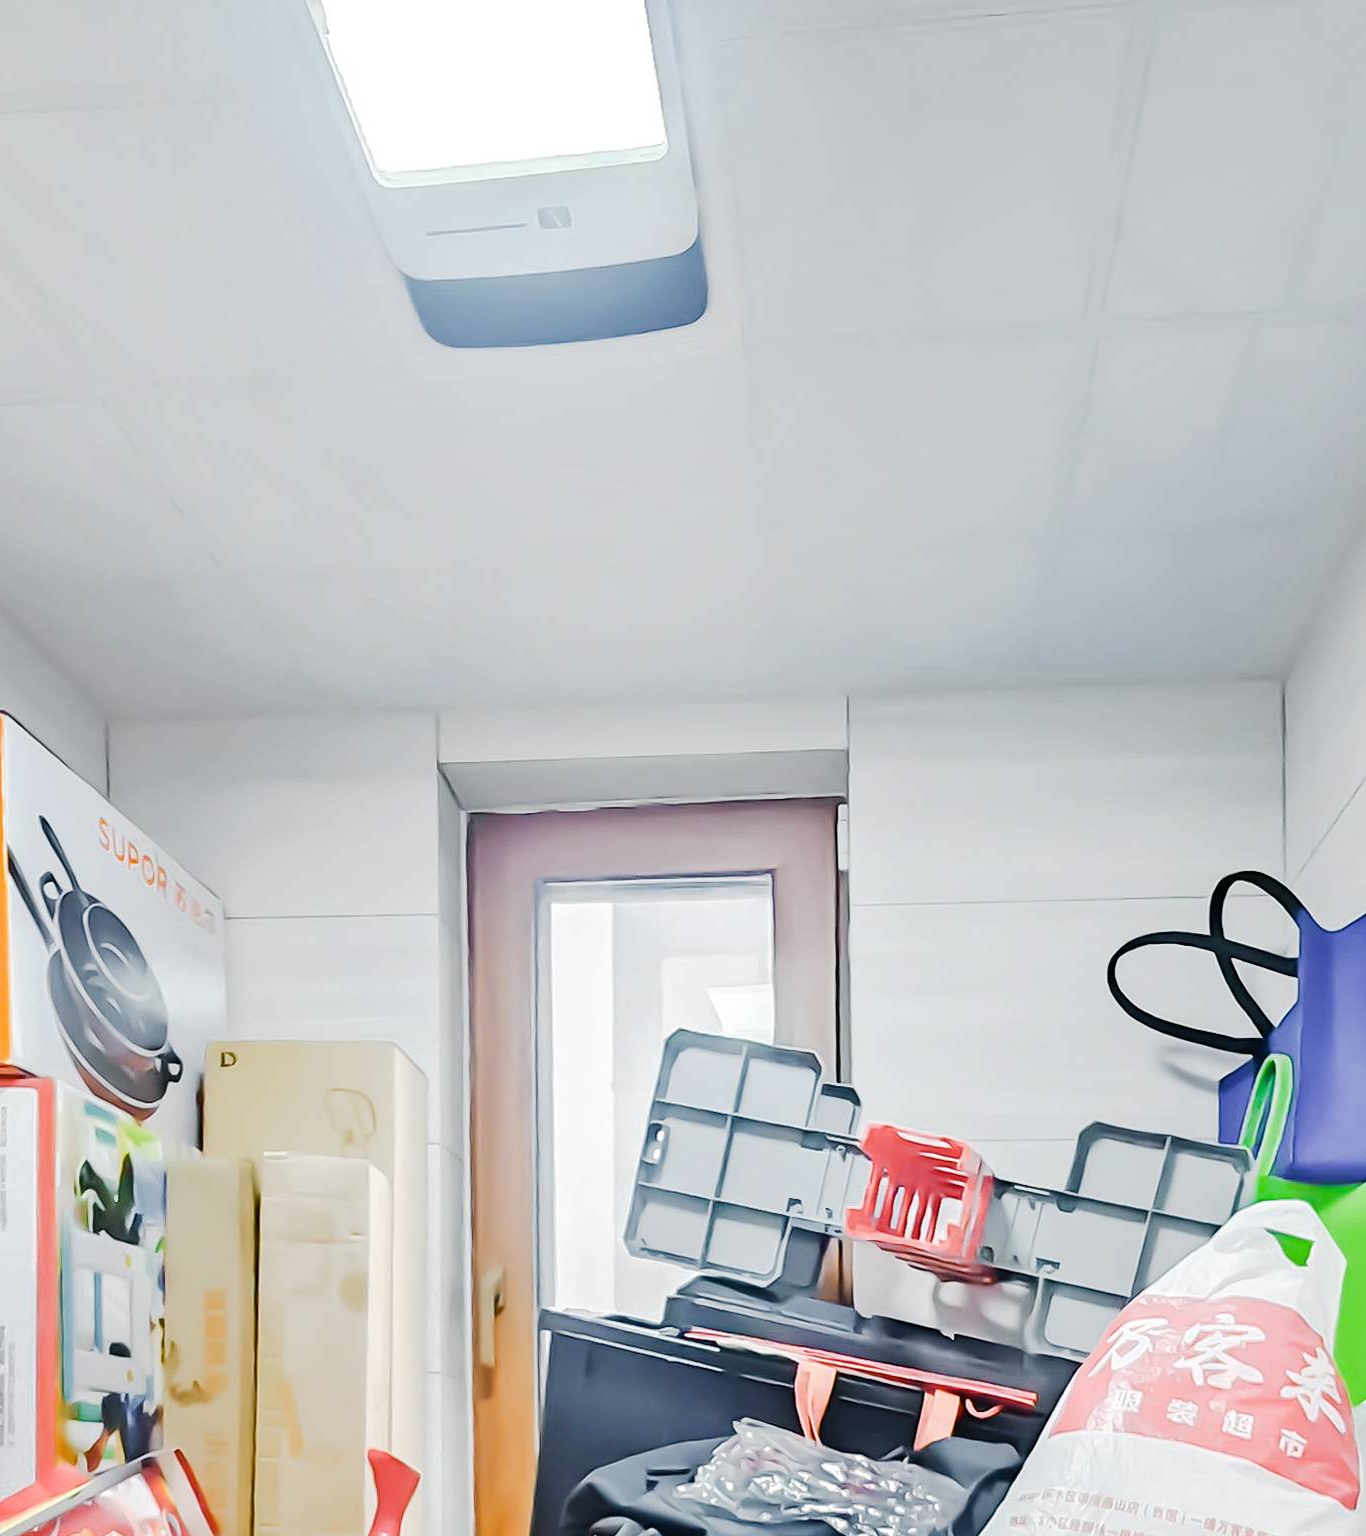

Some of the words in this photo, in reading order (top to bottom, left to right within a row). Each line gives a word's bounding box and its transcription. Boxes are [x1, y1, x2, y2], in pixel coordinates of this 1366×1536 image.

[220, 1051, 237, 1068] D
[1087, 1313, 1347, 1435] 万客来
